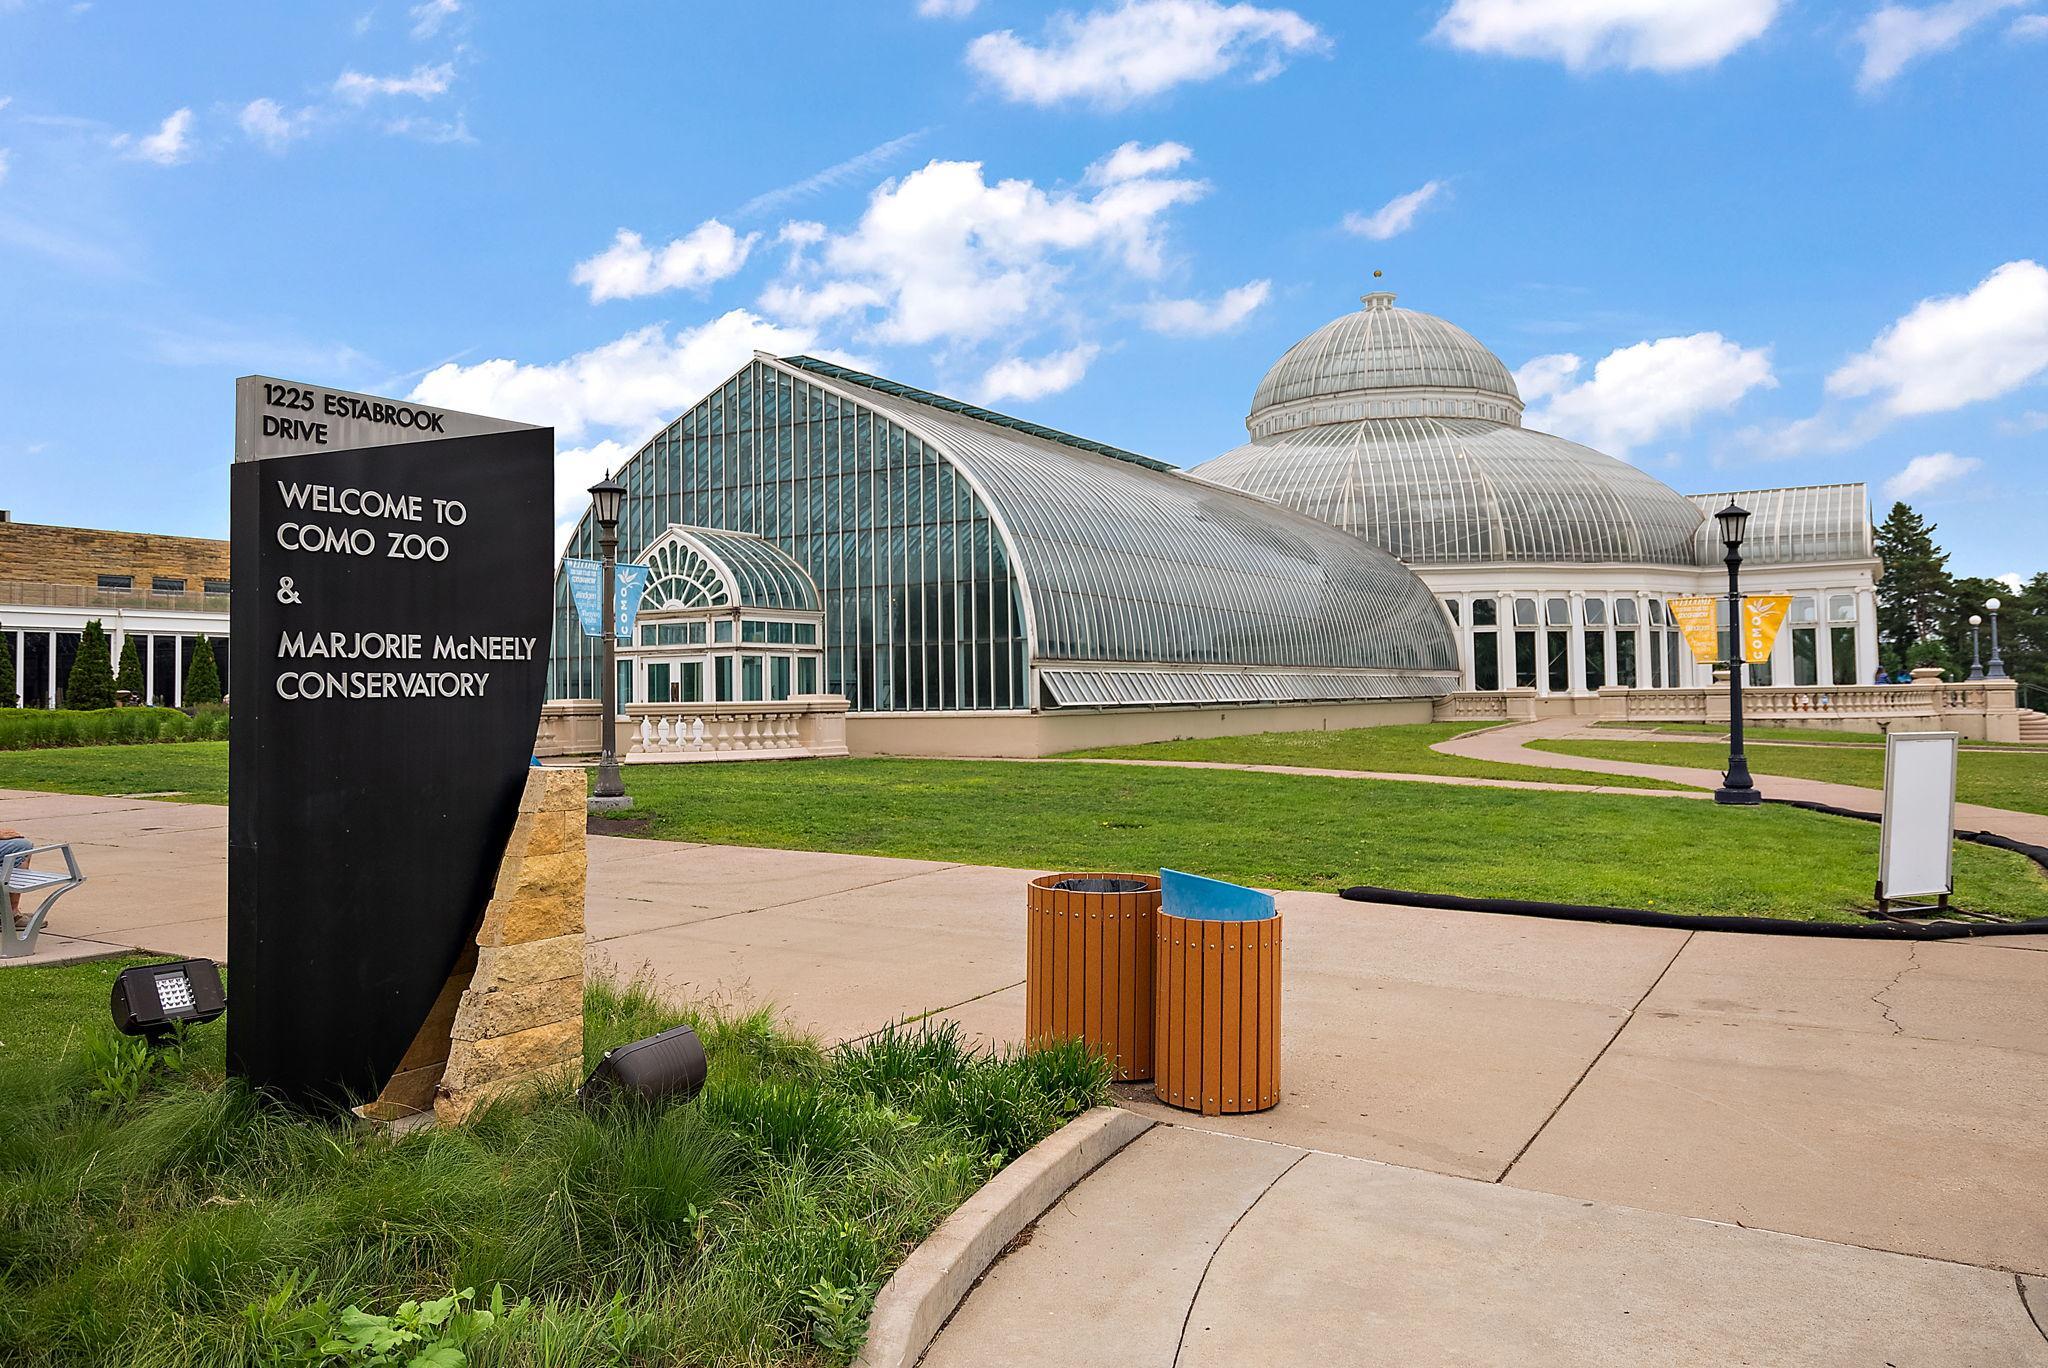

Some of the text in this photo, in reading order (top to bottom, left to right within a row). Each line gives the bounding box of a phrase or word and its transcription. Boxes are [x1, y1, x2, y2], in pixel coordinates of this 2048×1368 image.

[264, 384, 444, 433] 1225 ESTABROOK
[263, 415, 327, 444] DRIVE
[277, 481, 466, 525] WELCOME TO
[277, 523, 448, 562] COMO ZOO
[277, 577, 301, 604] &
[620, 588, 629, 635] COMO
[278, 631, 536, 660] MARJORIE McNEELY
[1751, 616, 1764, 659] COMO
[277, 672, 489, 700] CONSERVATORY
